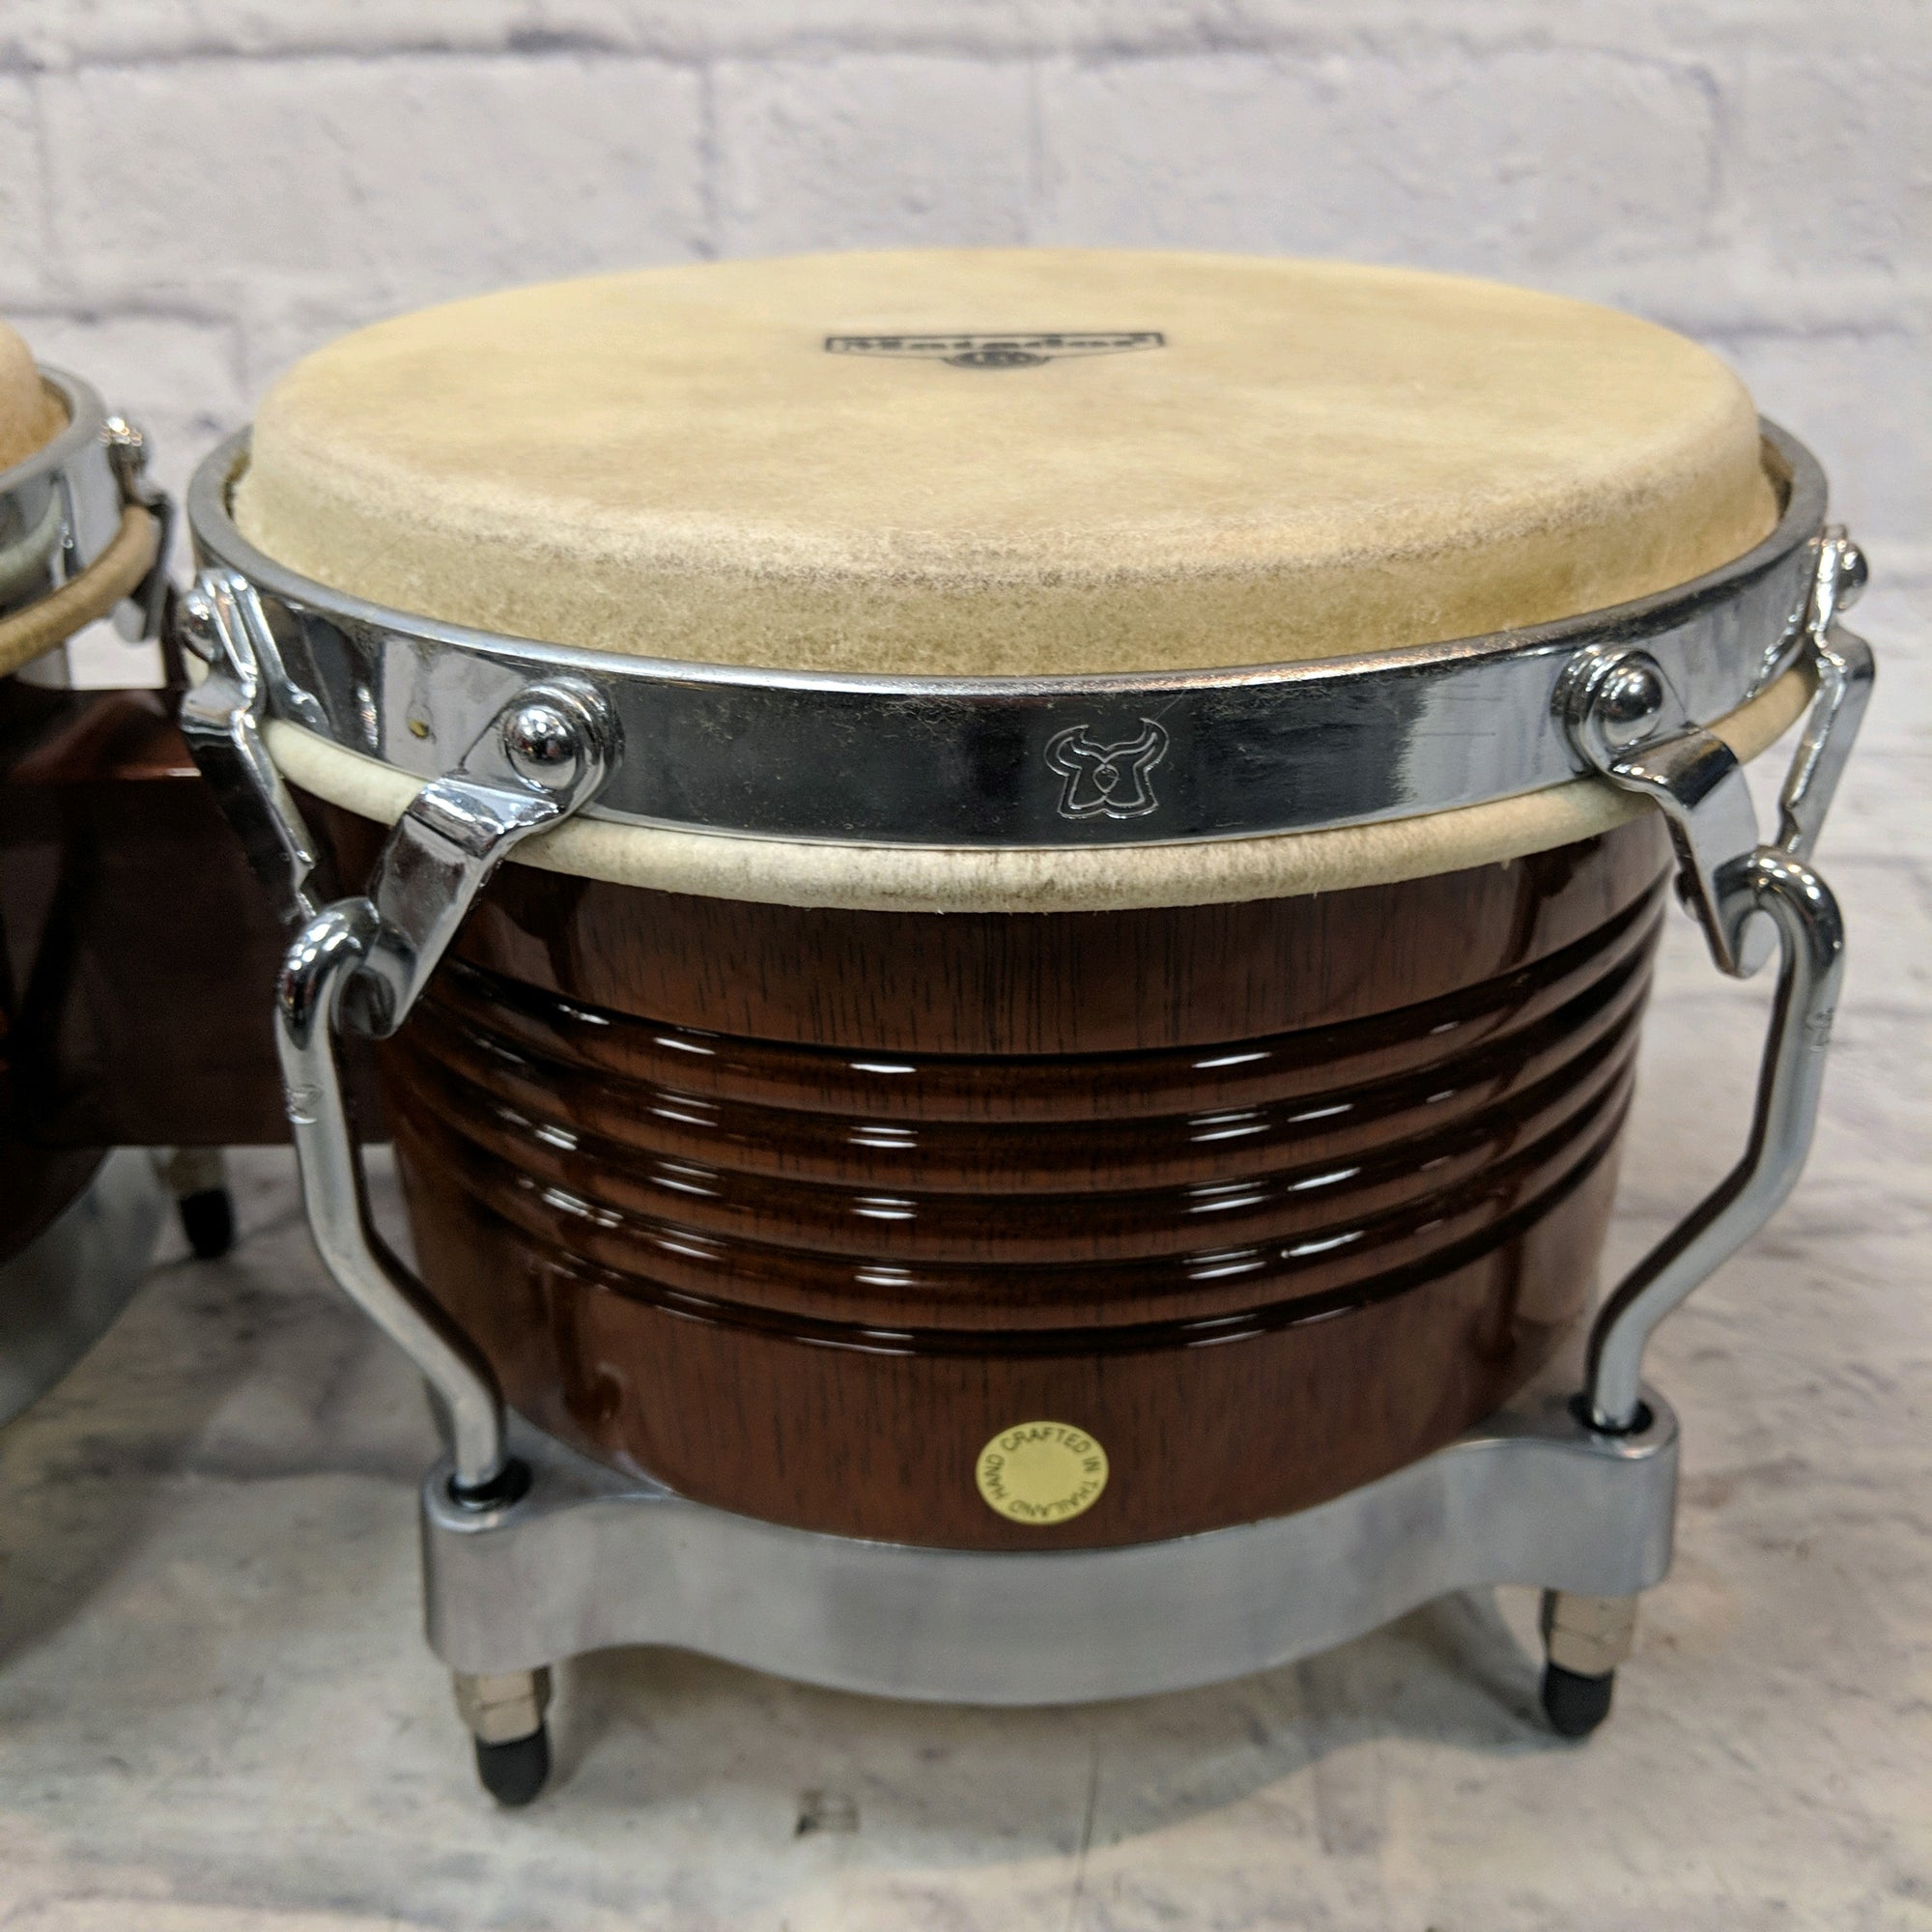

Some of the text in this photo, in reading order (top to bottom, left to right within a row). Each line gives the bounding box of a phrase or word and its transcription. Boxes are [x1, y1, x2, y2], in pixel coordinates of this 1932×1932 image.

[984, 1427, 1100, 1517] HAND CRAFTED IN THAILAND
